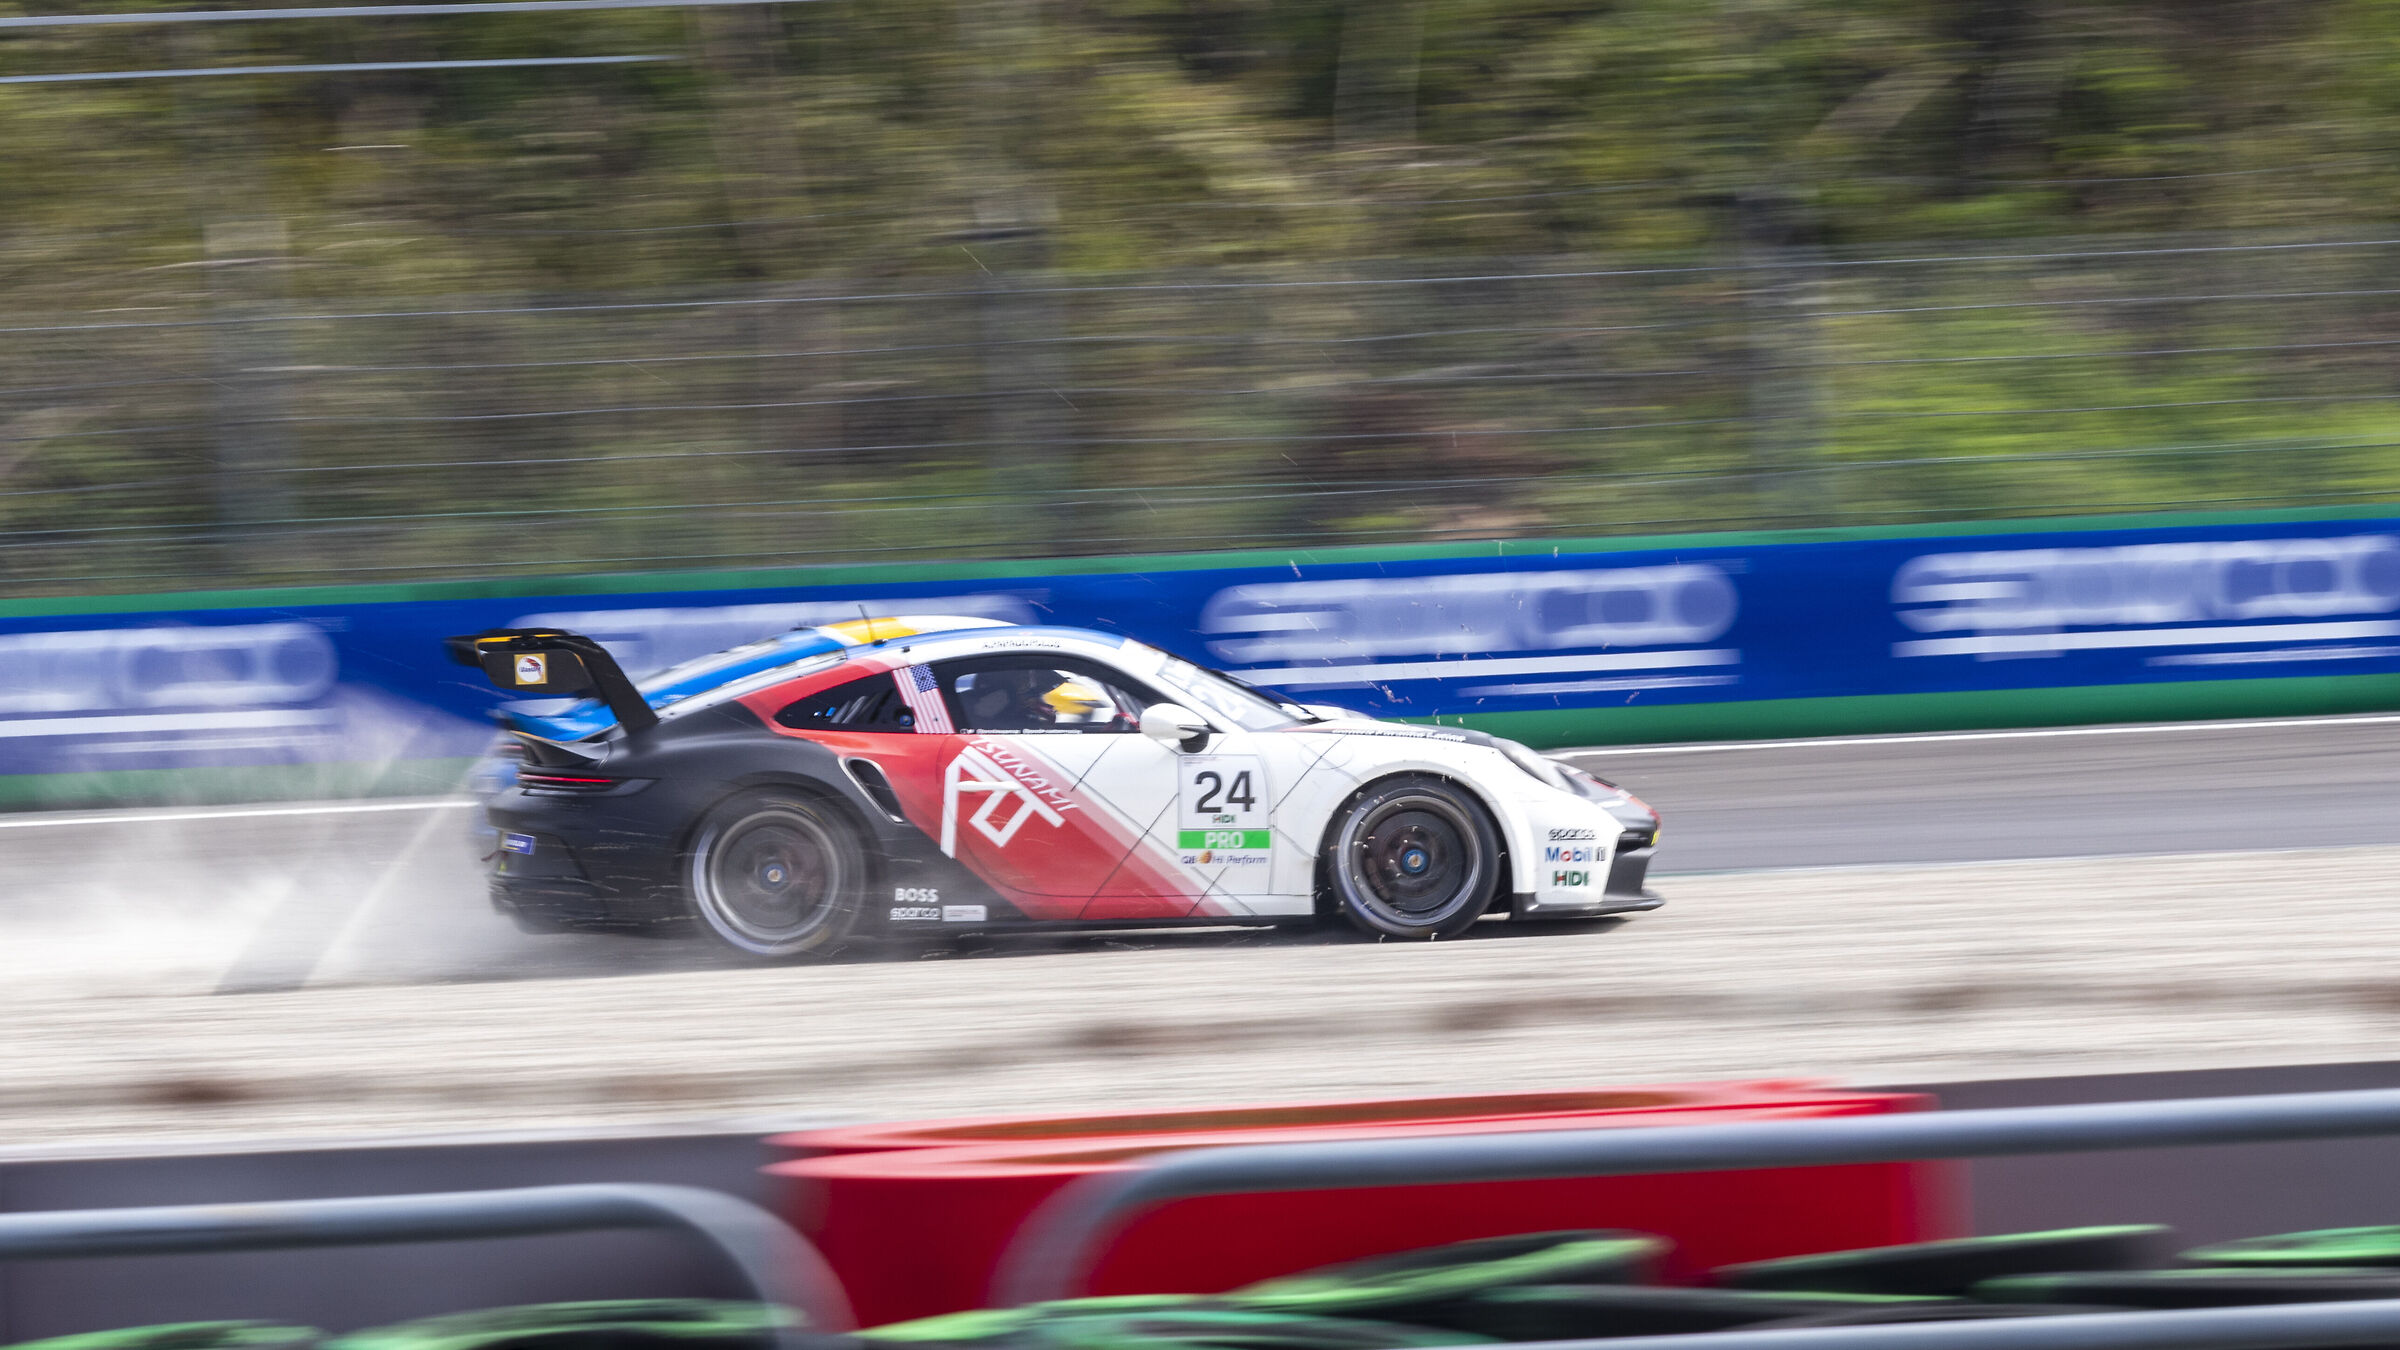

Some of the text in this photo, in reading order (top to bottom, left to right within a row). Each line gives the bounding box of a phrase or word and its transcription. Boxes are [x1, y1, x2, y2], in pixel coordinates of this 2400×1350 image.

[969, 739, 1080, 811] TSUNAMI
[1194, 769, 1256, 814] 24
[1211, 814, 1236, 824] HDI
[1205, 831, 1245, 849] PRO
[1226, 855, 1268, 867] Perform
[1545, 847, 1592, 863] Mobil
[1552, 870, 1590, 887] HDI
[894, 887, 940, 902] BOSS
[889, 907, 941, 920] sparco
